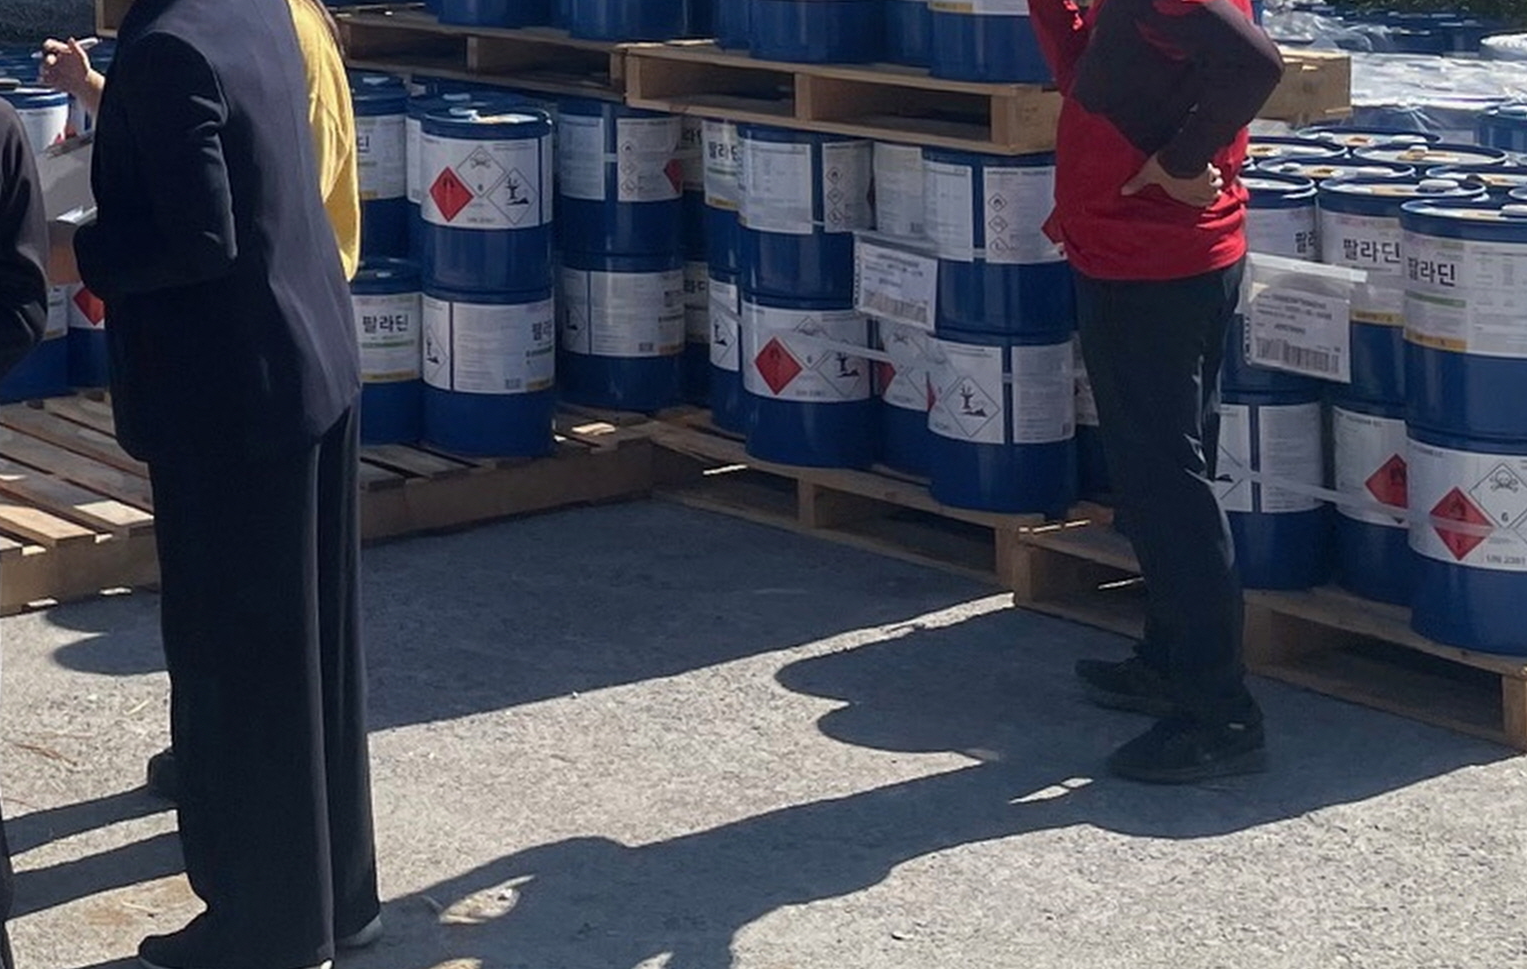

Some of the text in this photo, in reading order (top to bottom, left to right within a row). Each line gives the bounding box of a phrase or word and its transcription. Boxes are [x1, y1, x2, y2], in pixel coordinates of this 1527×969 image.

[1343, 238, 1401, 264] 팔라딘
[1407, 256, 1456, 288] 팔라딘
[362, 314, 409, 334] 팔라딘
